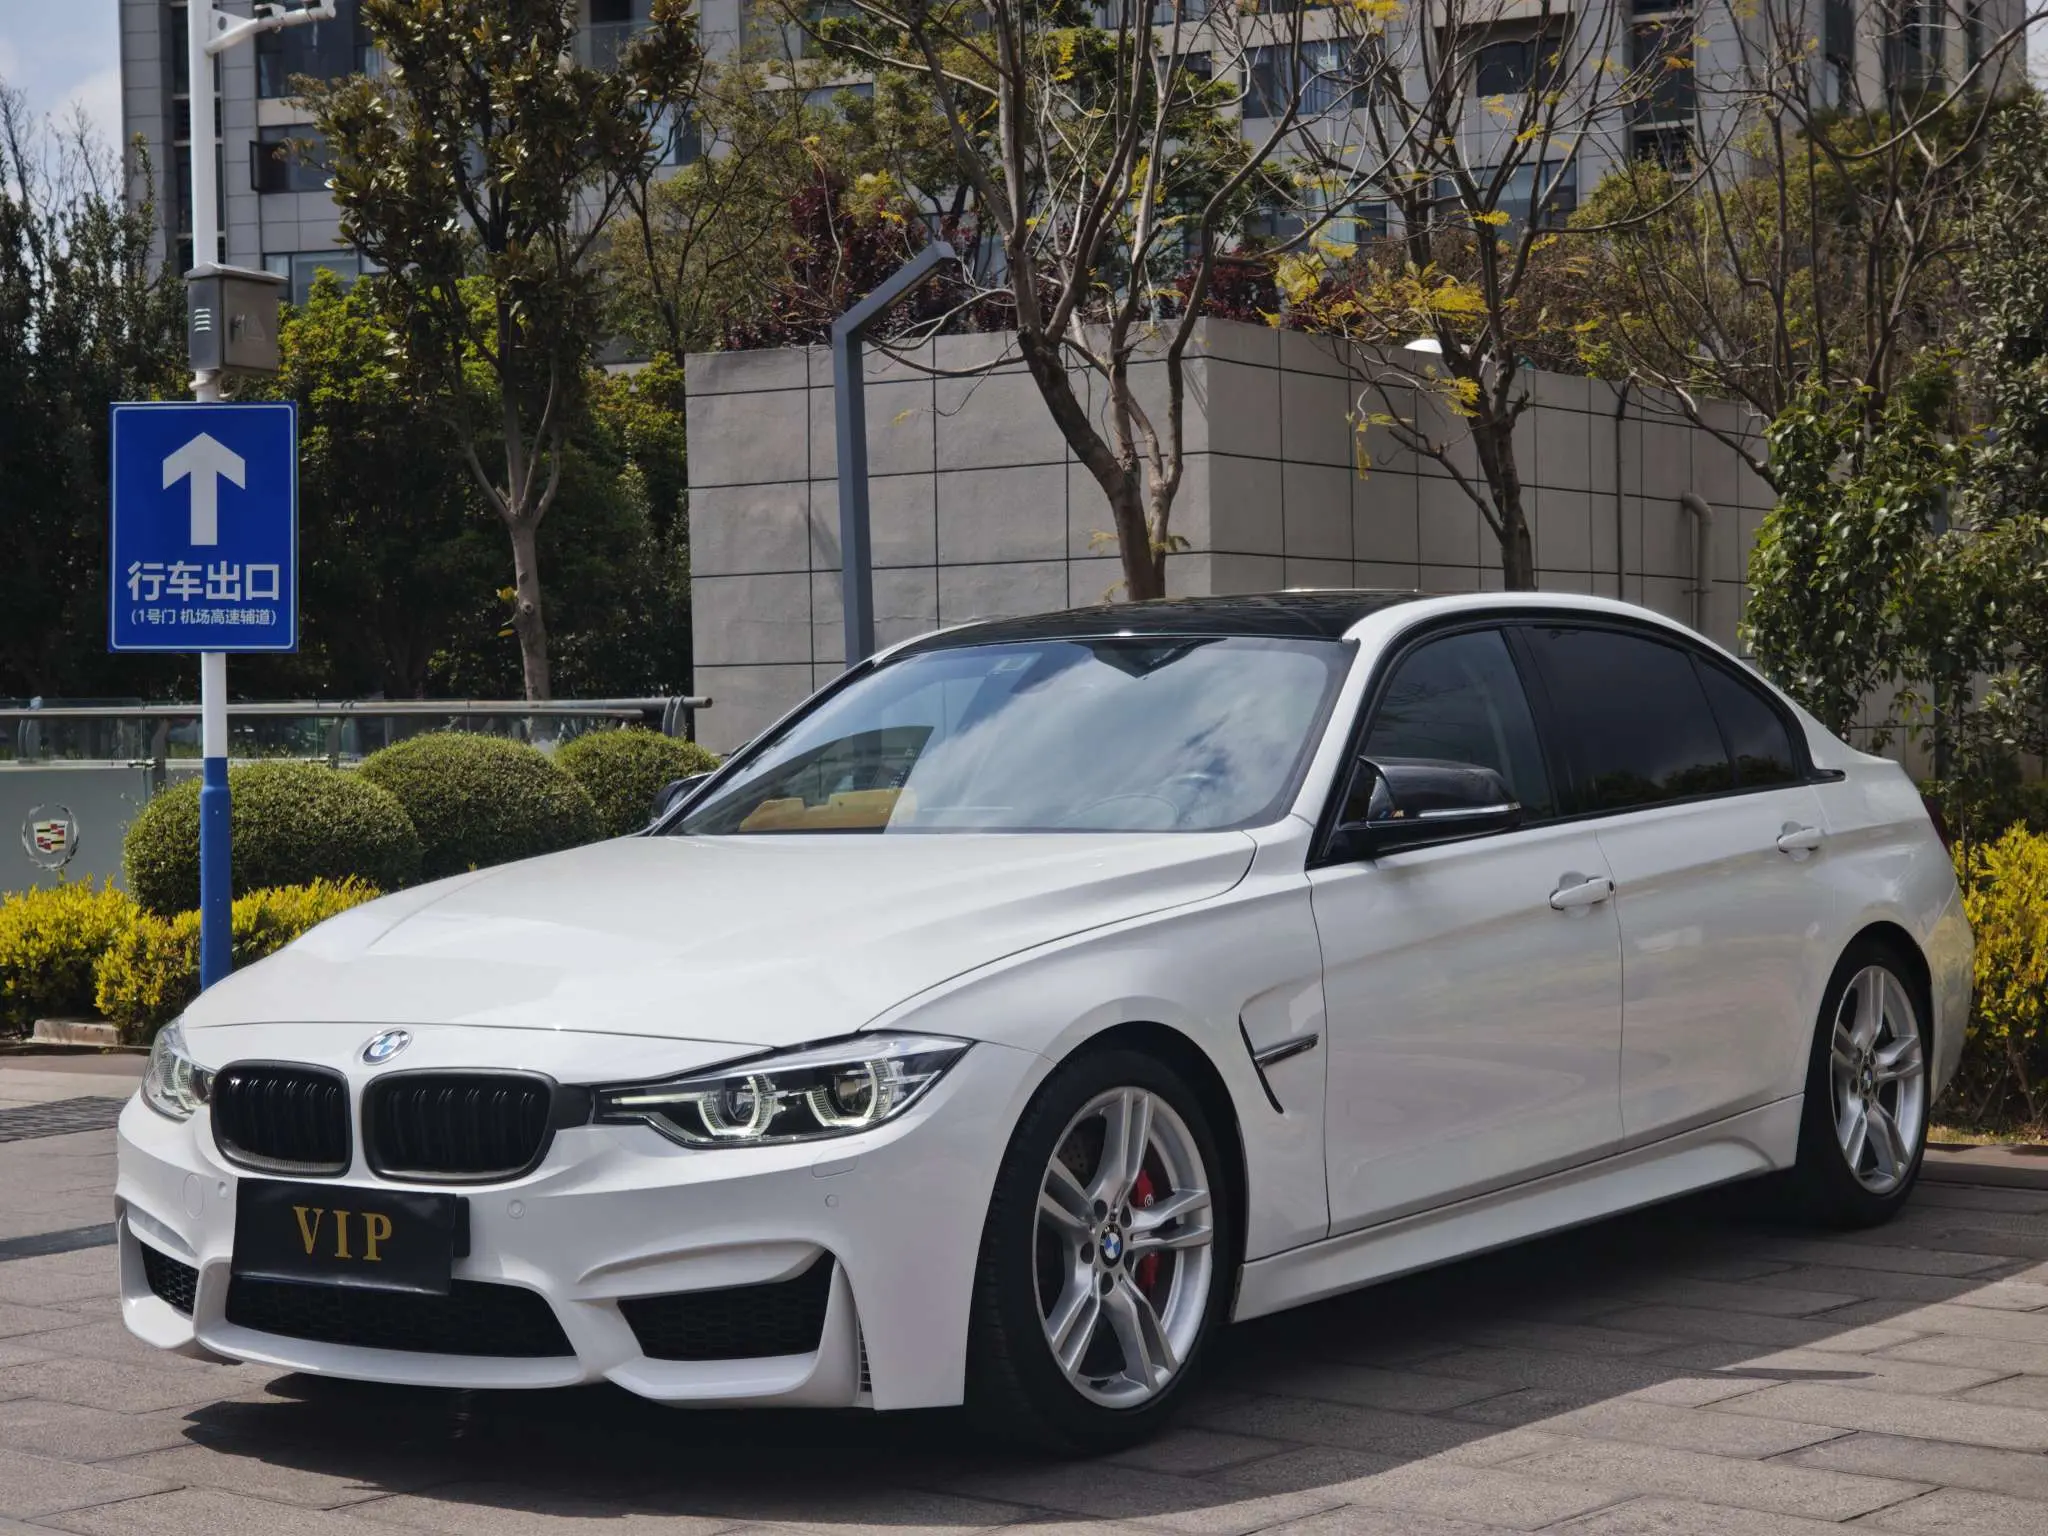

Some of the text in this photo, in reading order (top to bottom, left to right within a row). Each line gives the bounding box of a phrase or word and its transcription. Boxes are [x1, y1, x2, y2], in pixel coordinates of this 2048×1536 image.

[127, 561, 280, 602] 行车出口
[293, 1206, 393, 1261] VIP
